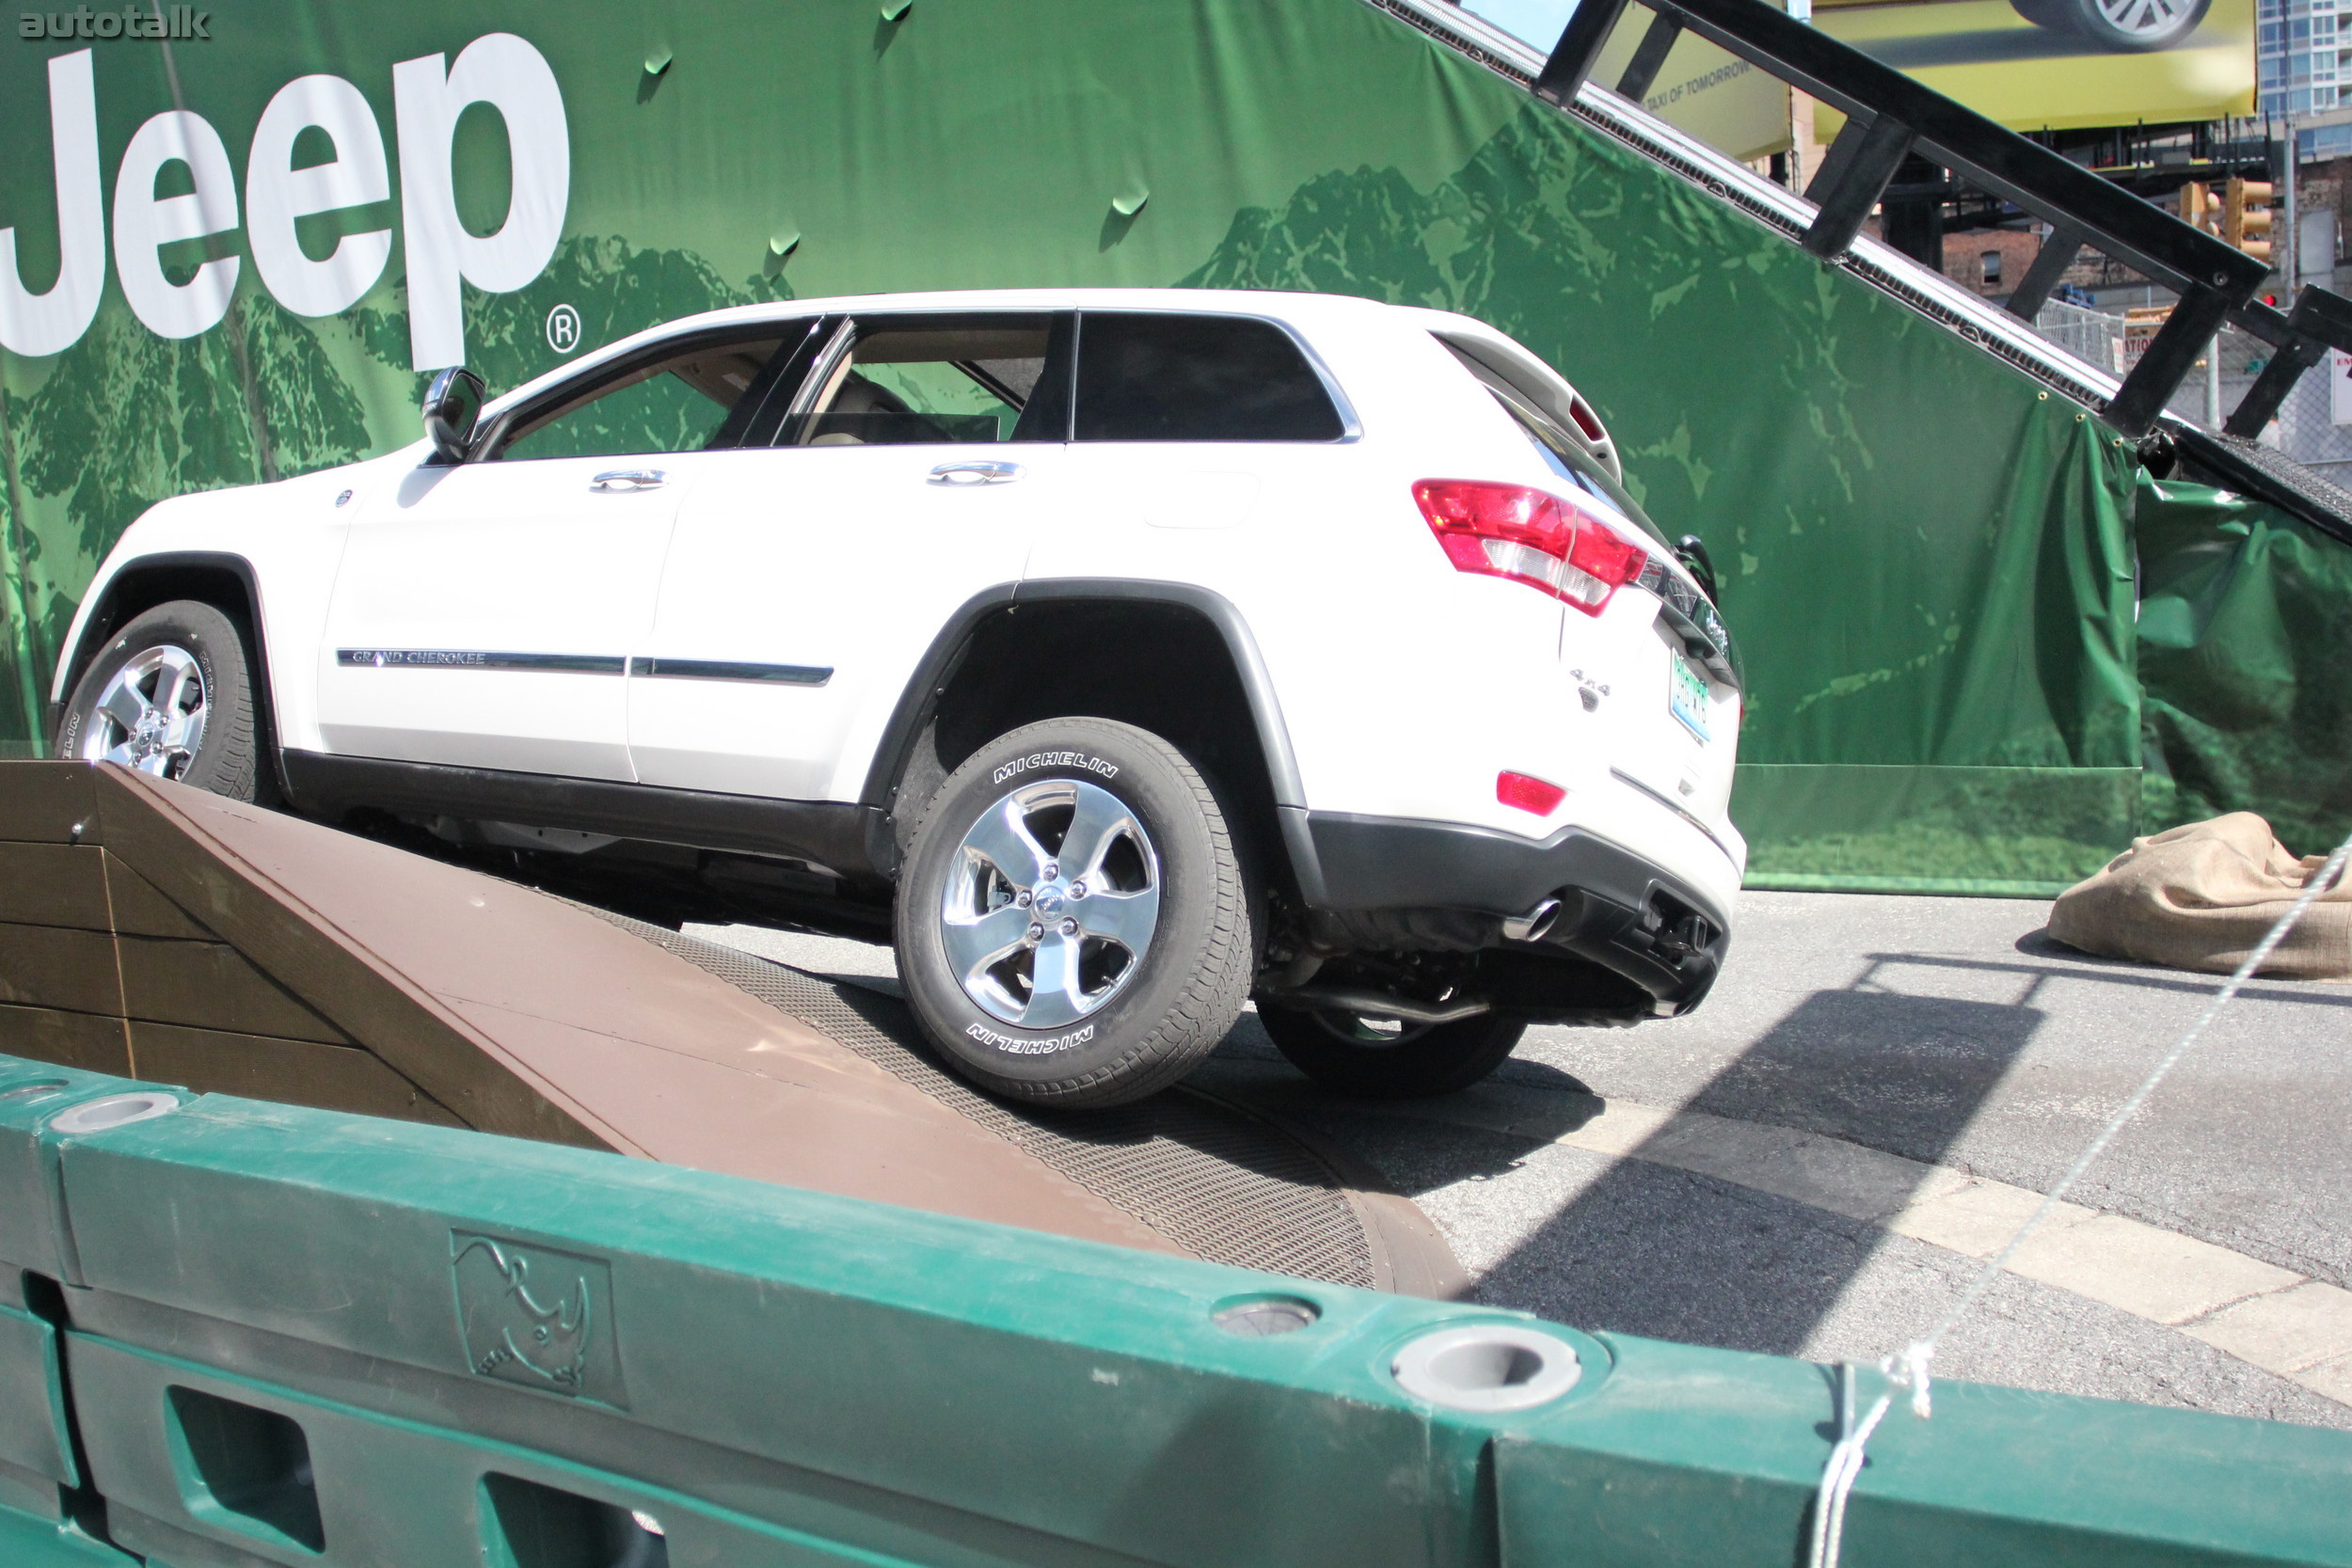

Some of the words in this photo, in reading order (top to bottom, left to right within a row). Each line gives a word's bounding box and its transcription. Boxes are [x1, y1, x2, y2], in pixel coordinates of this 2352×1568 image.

[1669, 85, 1684, 103] OF
[0, 32, 570, 372] Jeep
[352, 651, 403, 663] GRAND
[406, 652, 486, 665] CHEROKEE
[62, 712, 81, 759] ELIN
[993, 752, 1119, 784] MICHELIN
[966, 1022, 1095, 1055] MICHELIN
